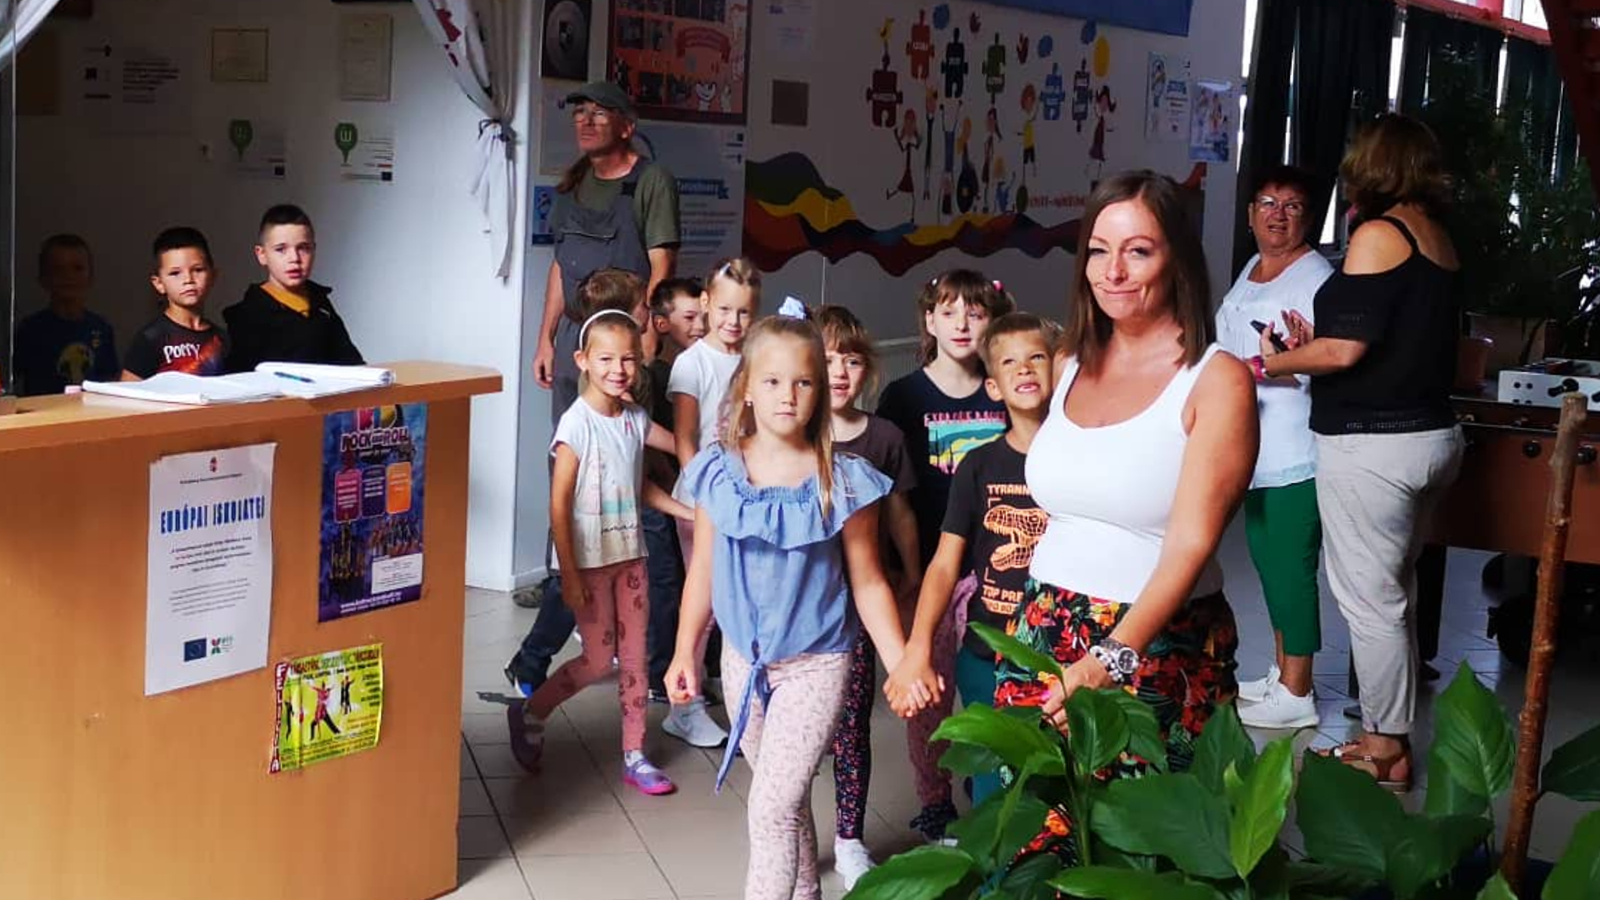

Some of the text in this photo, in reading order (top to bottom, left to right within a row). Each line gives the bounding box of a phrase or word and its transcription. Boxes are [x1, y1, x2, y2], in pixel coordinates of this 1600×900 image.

[341, 429, 373, 452] ROCK
[382, 426, 409, 447] ROLL
[161, 503, 208, 534] EURÓPAI
[982, 584, 1000, 599] TOP
